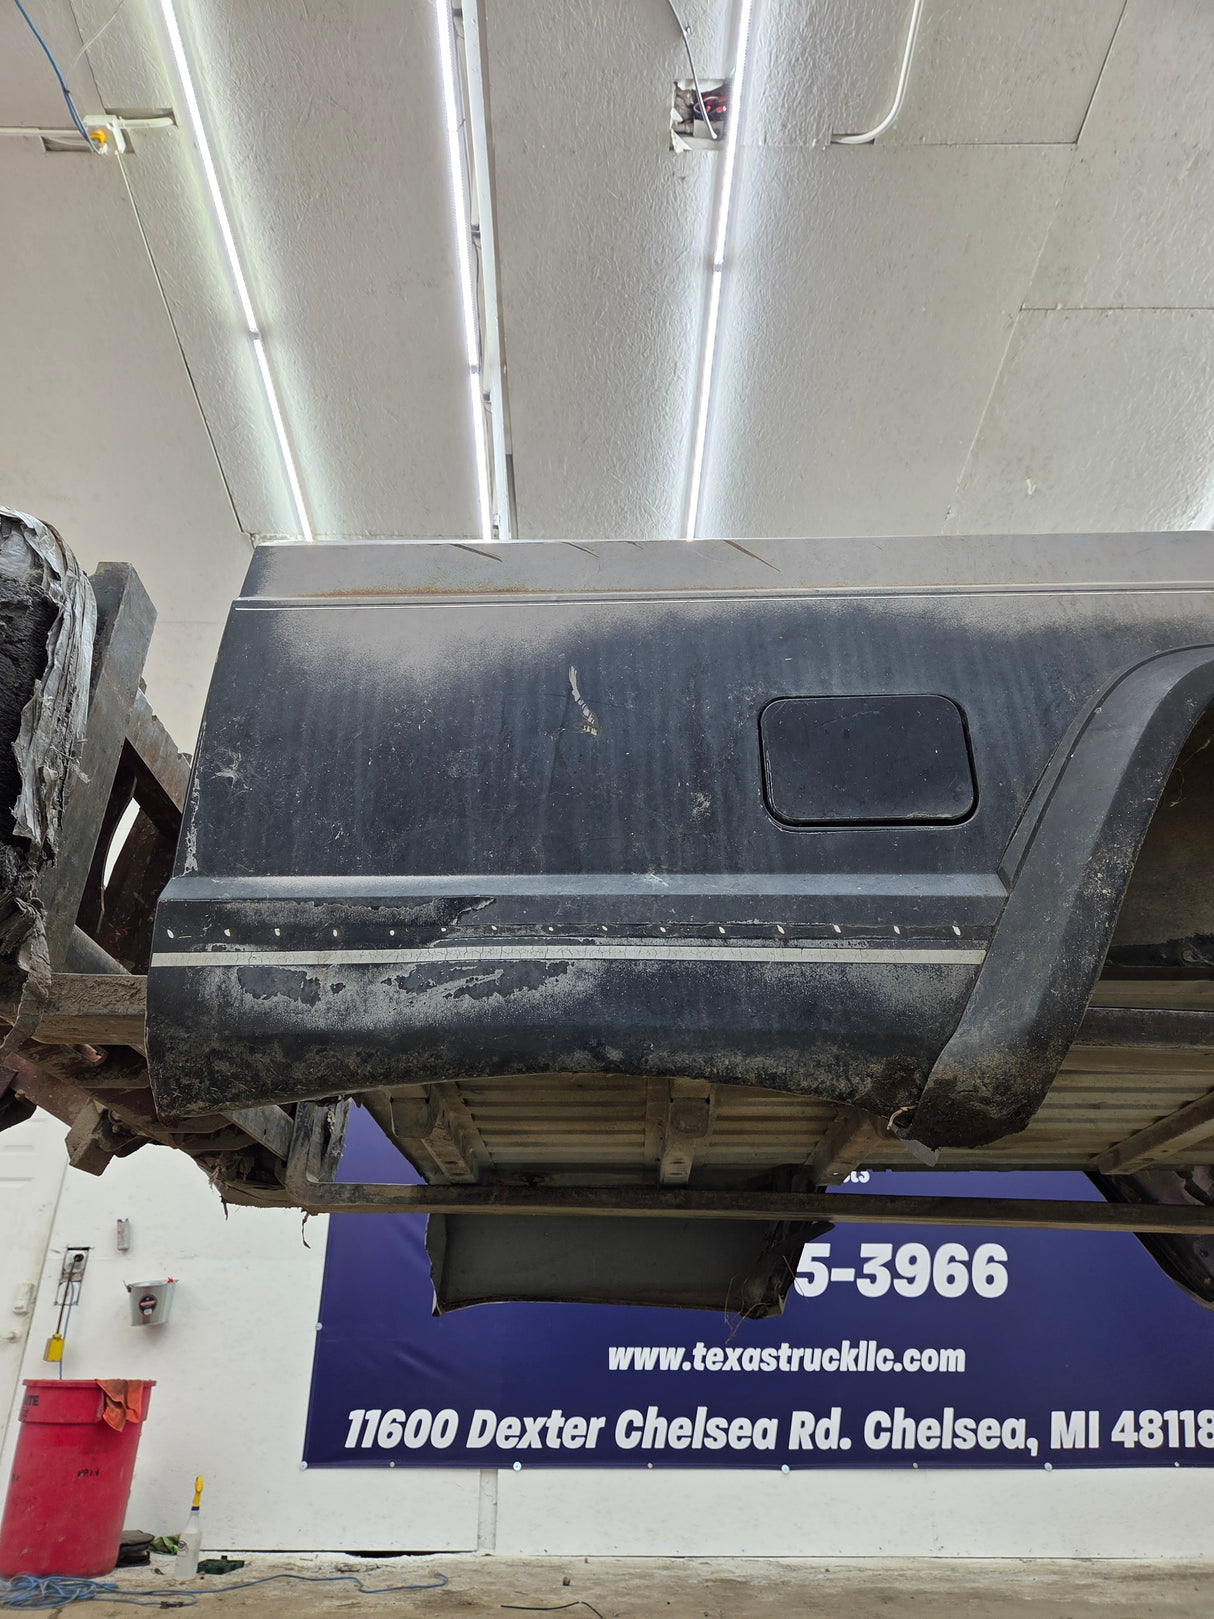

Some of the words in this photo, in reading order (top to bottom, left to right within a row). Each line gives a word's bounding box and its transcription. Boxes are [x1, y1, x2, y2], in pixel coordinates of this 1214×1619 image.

[608, 1339, 966, 1373] www.texastruckllc.com
[344, 1408, 459, 1450] 11600
[465, 1409, 607, 1450] Dexter
[614, 1405, 779, 1450] Chelsea
[788, 1406, 852, 1450] Rd.
[863, 1407, 1039, 1457] Chelsea,
[1050, 1410, 1100, 1449] MI
[1111, 1409, 1214, 1449] 48118
